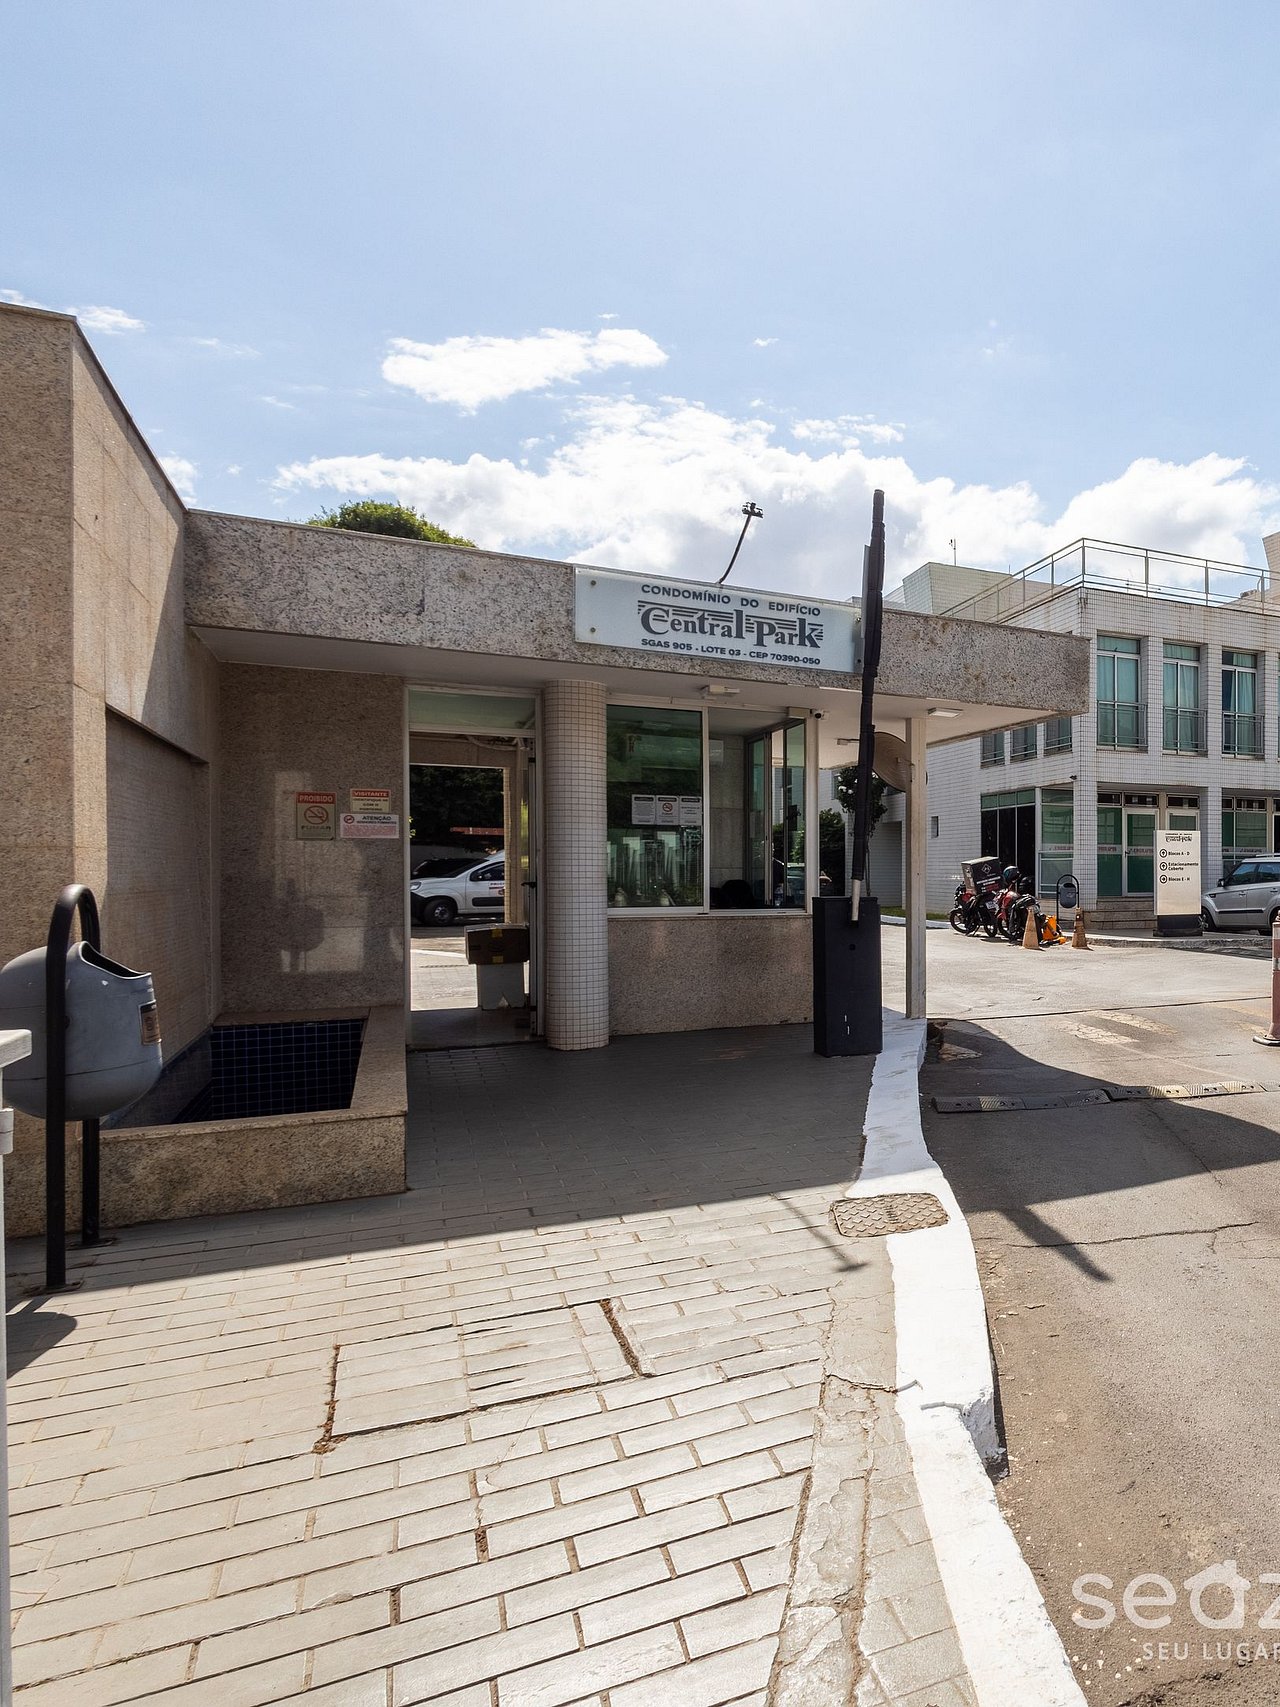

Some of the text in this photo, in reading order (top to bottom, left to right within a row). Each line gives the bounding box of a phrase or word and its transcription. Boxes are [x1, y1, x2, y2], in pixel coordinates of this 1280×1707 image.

[641, 584, 821, 617] CONDOMÍNIO DO EDIFÍCIO
[640, 606, 821, 649] Central Park
[641, 638, 670, 648] SGAS
[672, 642, 693, 651] 905
[701, 645, 726, 655] LOTE
[728, 648, 741, 656] 03
[749, 650, 769, 659] CEP
[770, 653, 821, 665] 70390-050
